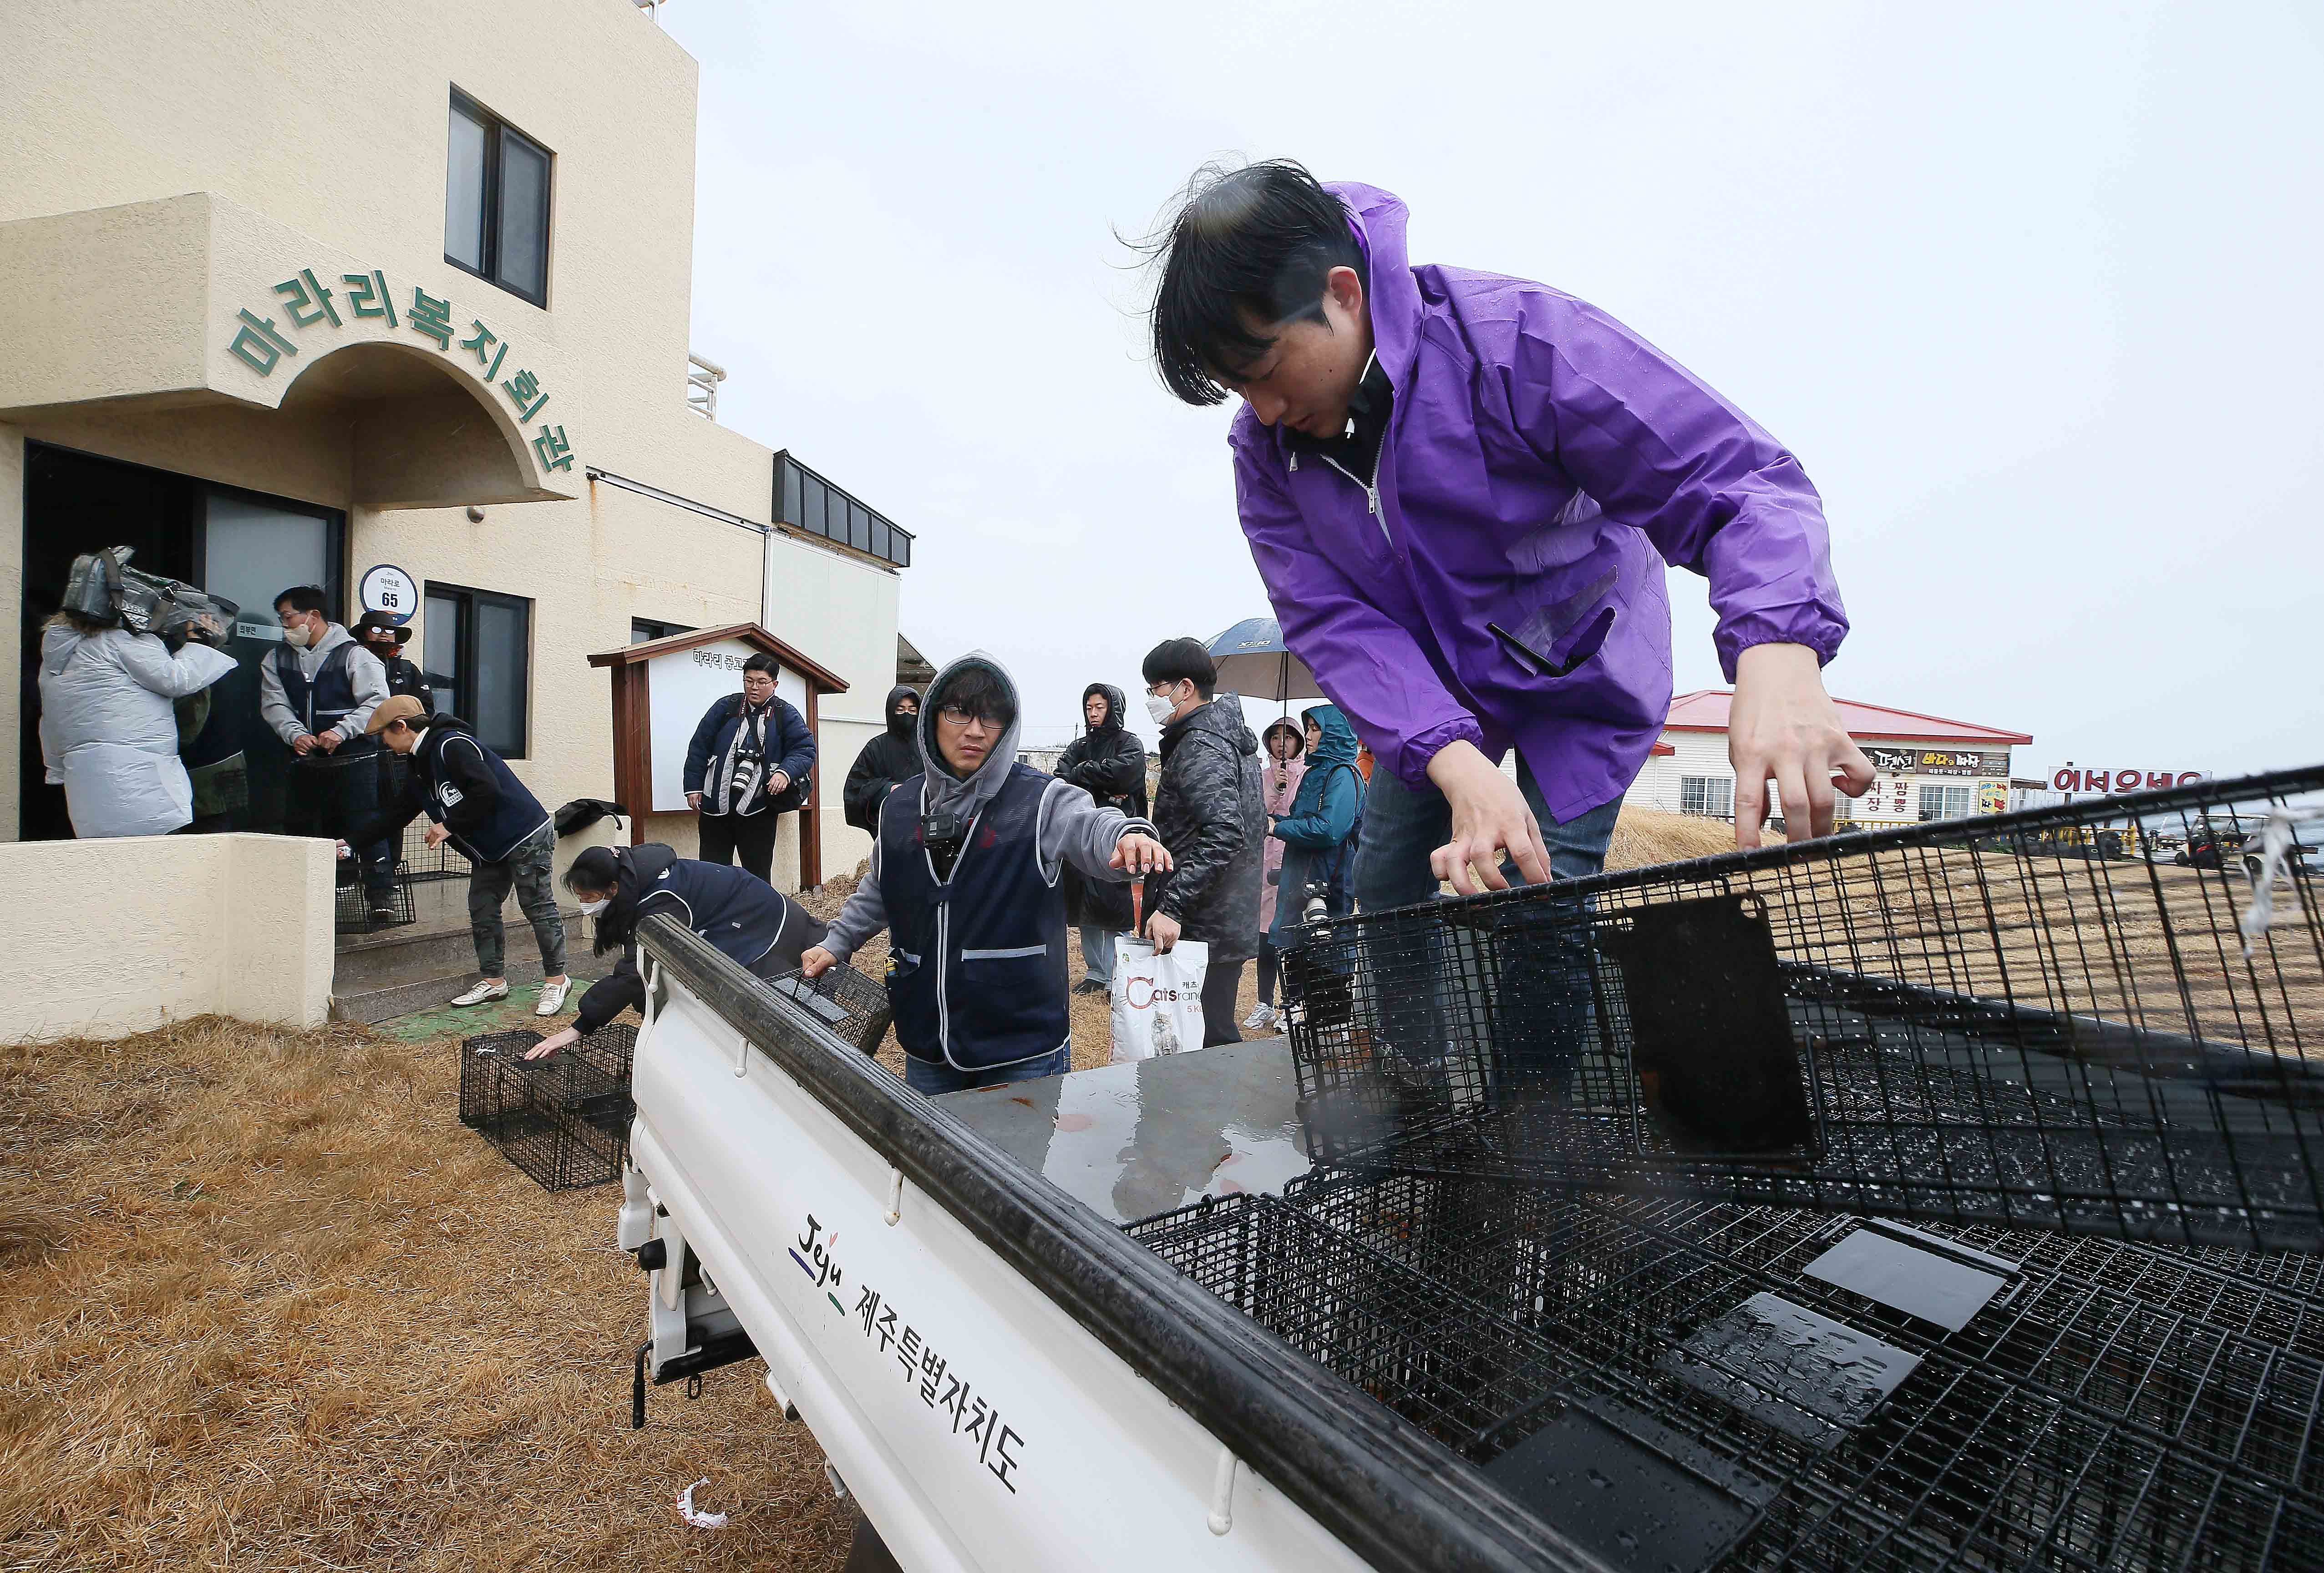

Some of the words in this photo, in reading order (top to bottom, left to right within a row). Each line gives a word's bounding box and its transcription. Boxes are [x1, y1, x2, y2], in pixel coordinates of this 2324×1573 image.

[227, 268, 574, 472] 마라리복지회관
[381, 578, 400, 587] 마라로
[382, 592, 398, 608] 65
[693, 651, 722, 669] 마라리
[1874, 750, 1913, 770] 펜션
[1893, 782, 1908, 812] 짬뽕
[1182, 980, 1198, 989] 캐츠
[798, 1213, 842, 1288] Jeju
[854, 1284, 1025, 1495] 제주특별자치도
